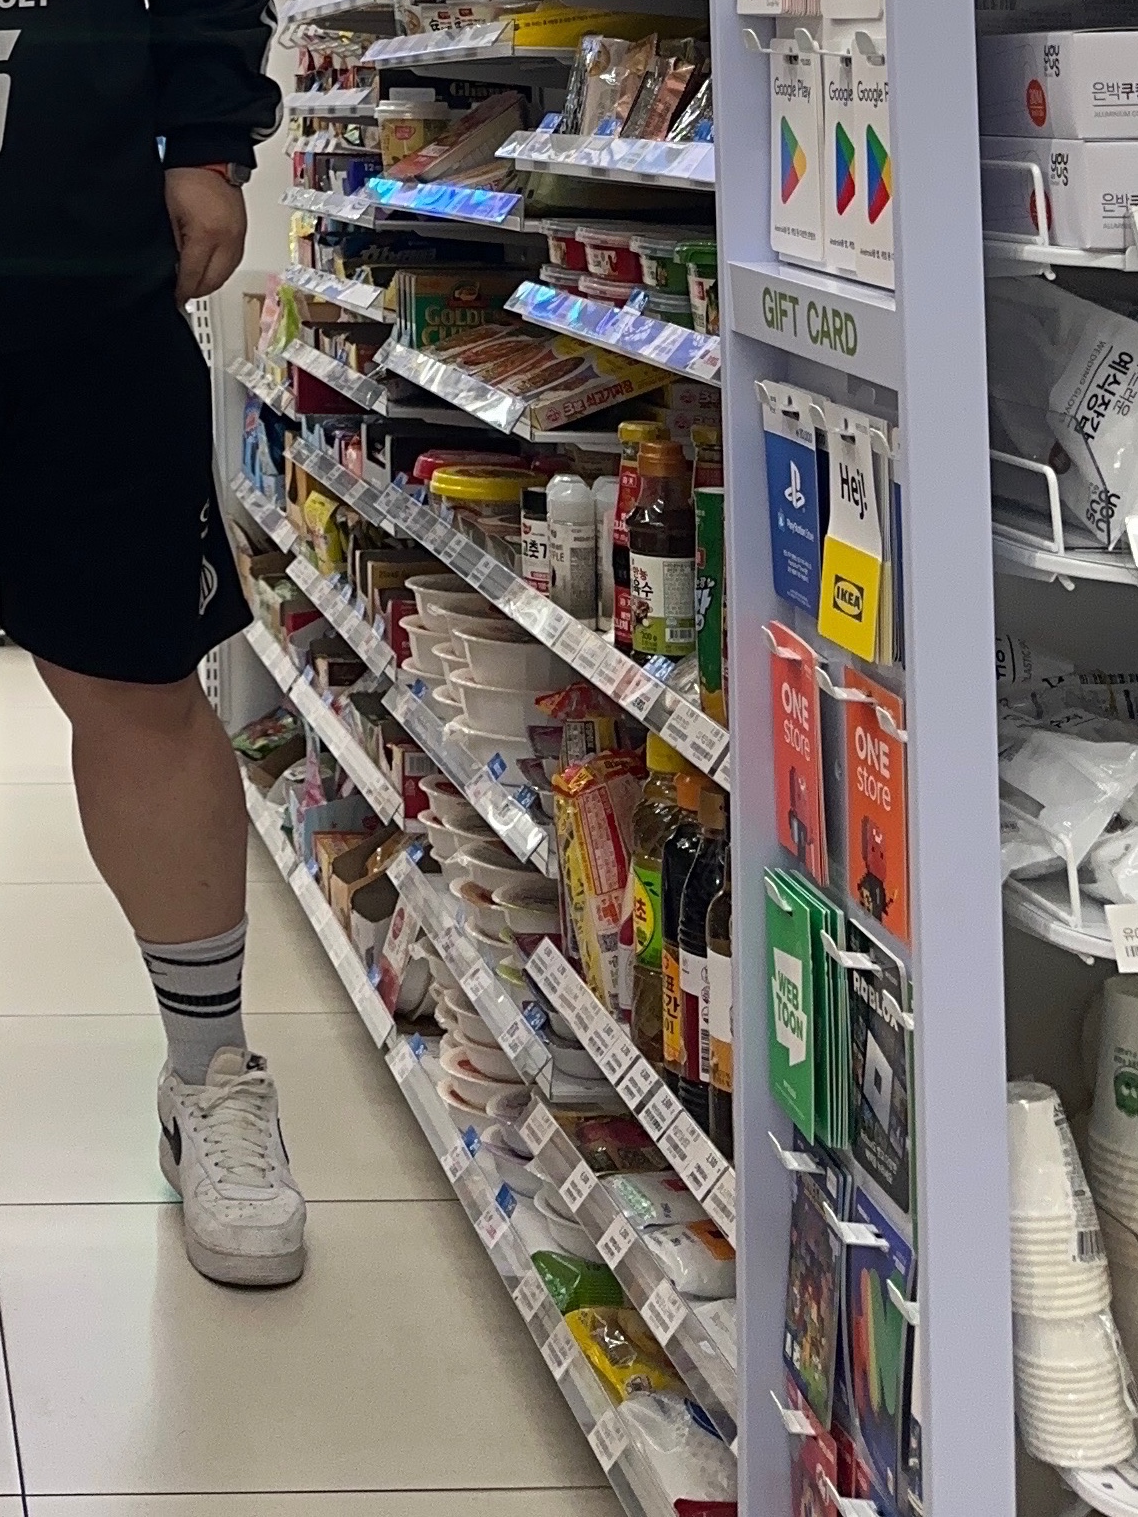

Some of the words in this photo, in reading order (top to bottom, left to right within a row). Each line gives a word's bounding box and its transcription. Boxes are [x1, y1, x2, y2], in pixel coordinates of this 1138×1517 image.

[774, 77, 797, 102] Google
[797, 78, 811, 103] Play
[828, 81, 853, 107] Google
[856, 81, 883, 108] Google
[762, 286, 800, 337] GIFT
[806, 300, 859, 357] CARD
[838, 461, 869, 521] Hej!
[836, 585, 861, 611] IKEA
[781, 681, 810, 732] ONE
[783, 718, 811, 762] store
[854, 726, 891, 780] ONE
[856, 765, 891, 812] store
[776, 969, 800, 1012] WEB
[776, 992, 804, 1042] TOON
